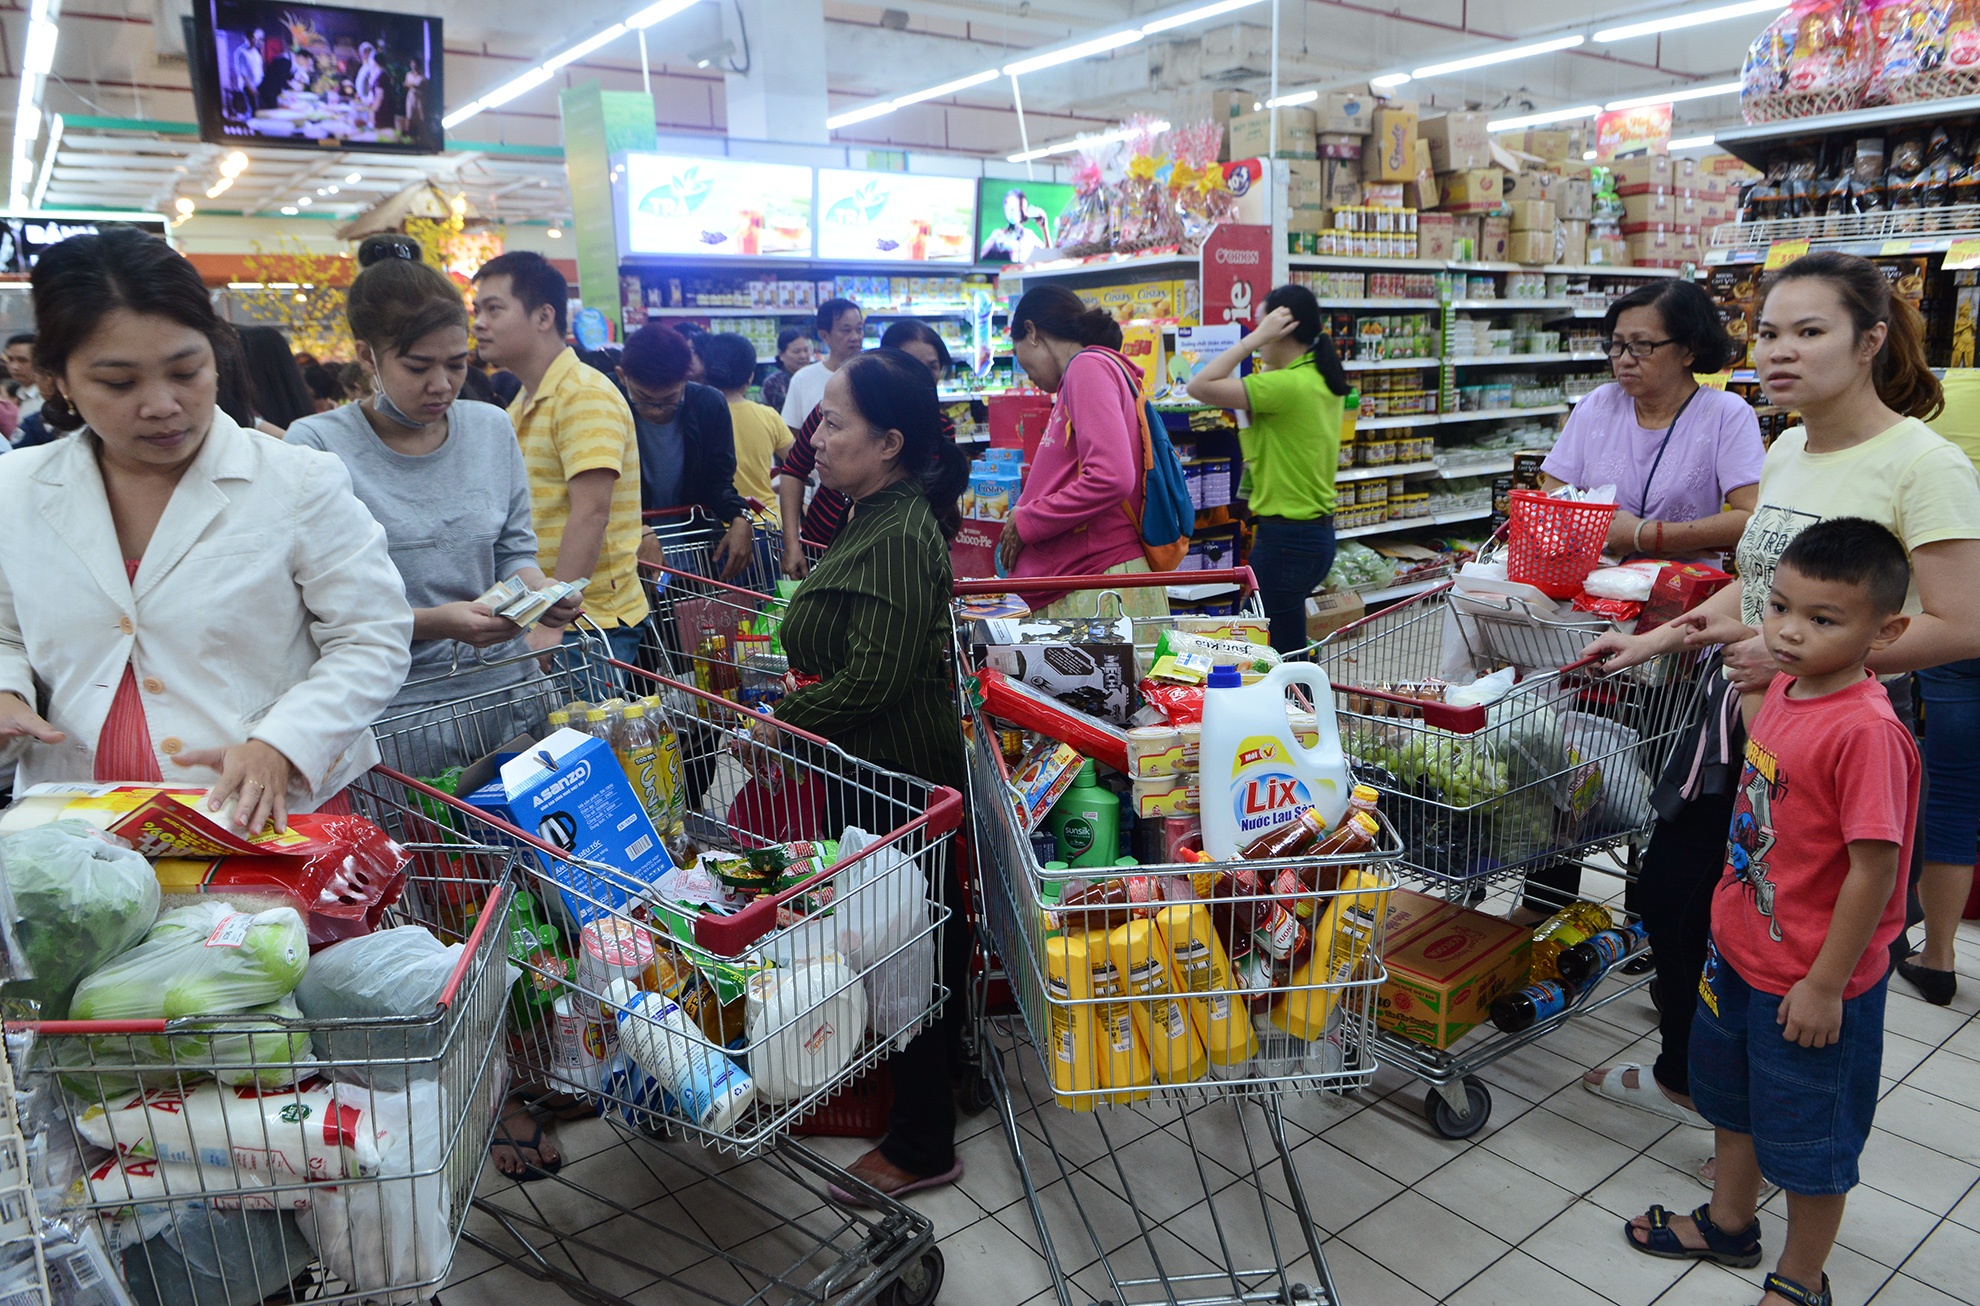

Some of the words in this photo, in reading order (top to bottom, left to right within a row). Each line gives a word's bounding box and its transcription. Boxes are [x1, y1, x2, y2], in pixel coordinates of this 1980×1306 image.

[1223, 280, 1252, 323] ie
[533, 766, 587, 808] Asanzo
[1245, 777, 1299, 815] Lix
[1065, 826, 1090, 837] sunsilk
[1241, 816, 1271, 832] Nước
[1272, 810, 1292, 825] Lau
